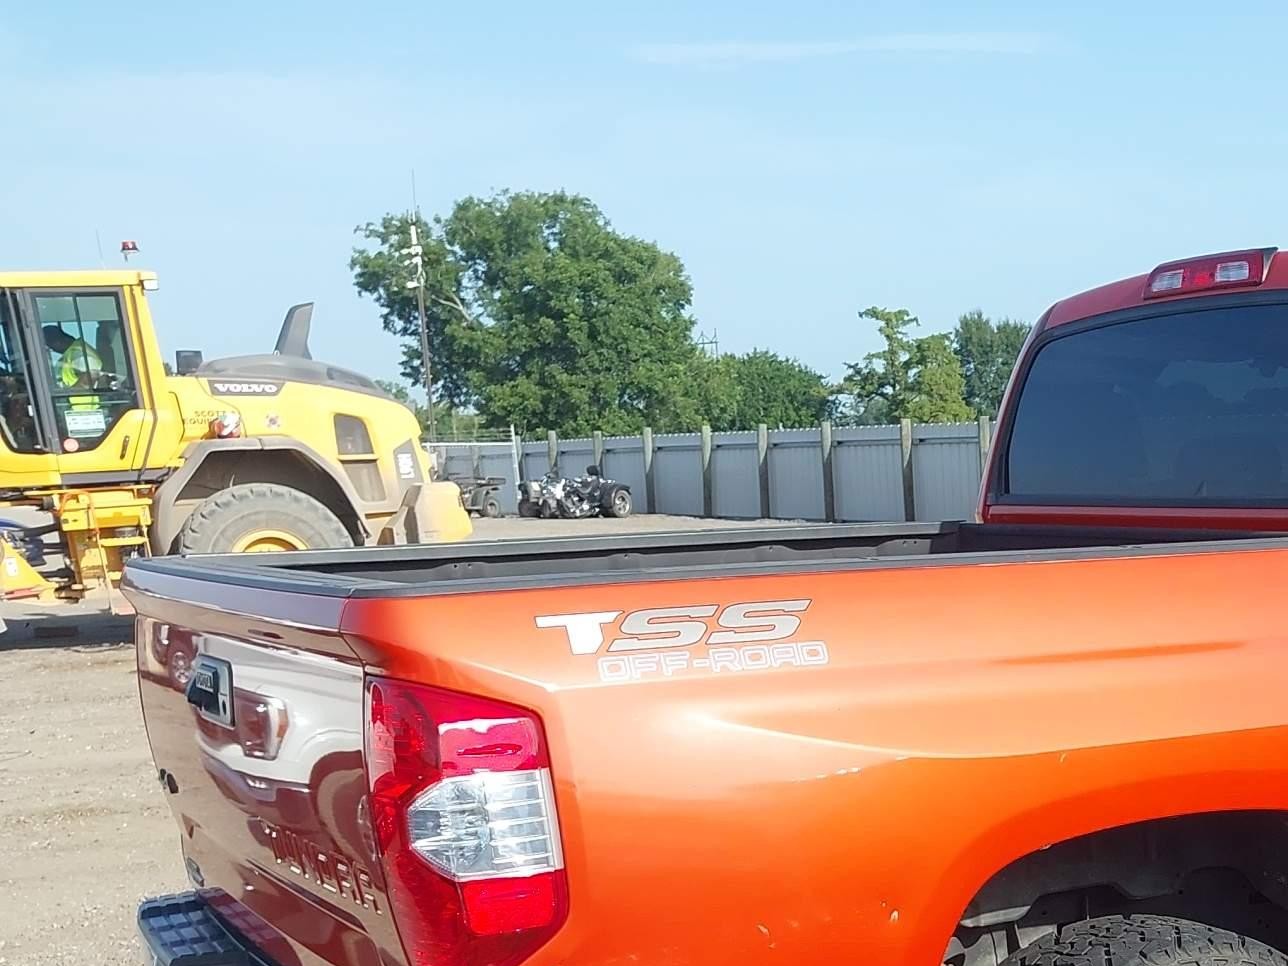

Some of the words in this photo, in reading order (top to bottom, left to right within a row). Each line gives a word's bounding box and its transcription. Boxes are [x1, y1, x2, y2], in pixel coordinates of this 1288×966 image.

[214, 383, 278, 393] VOLVO
[534, 599, 812, 656] TSS
[597, 640, 830, 682] OFF-ROAD
